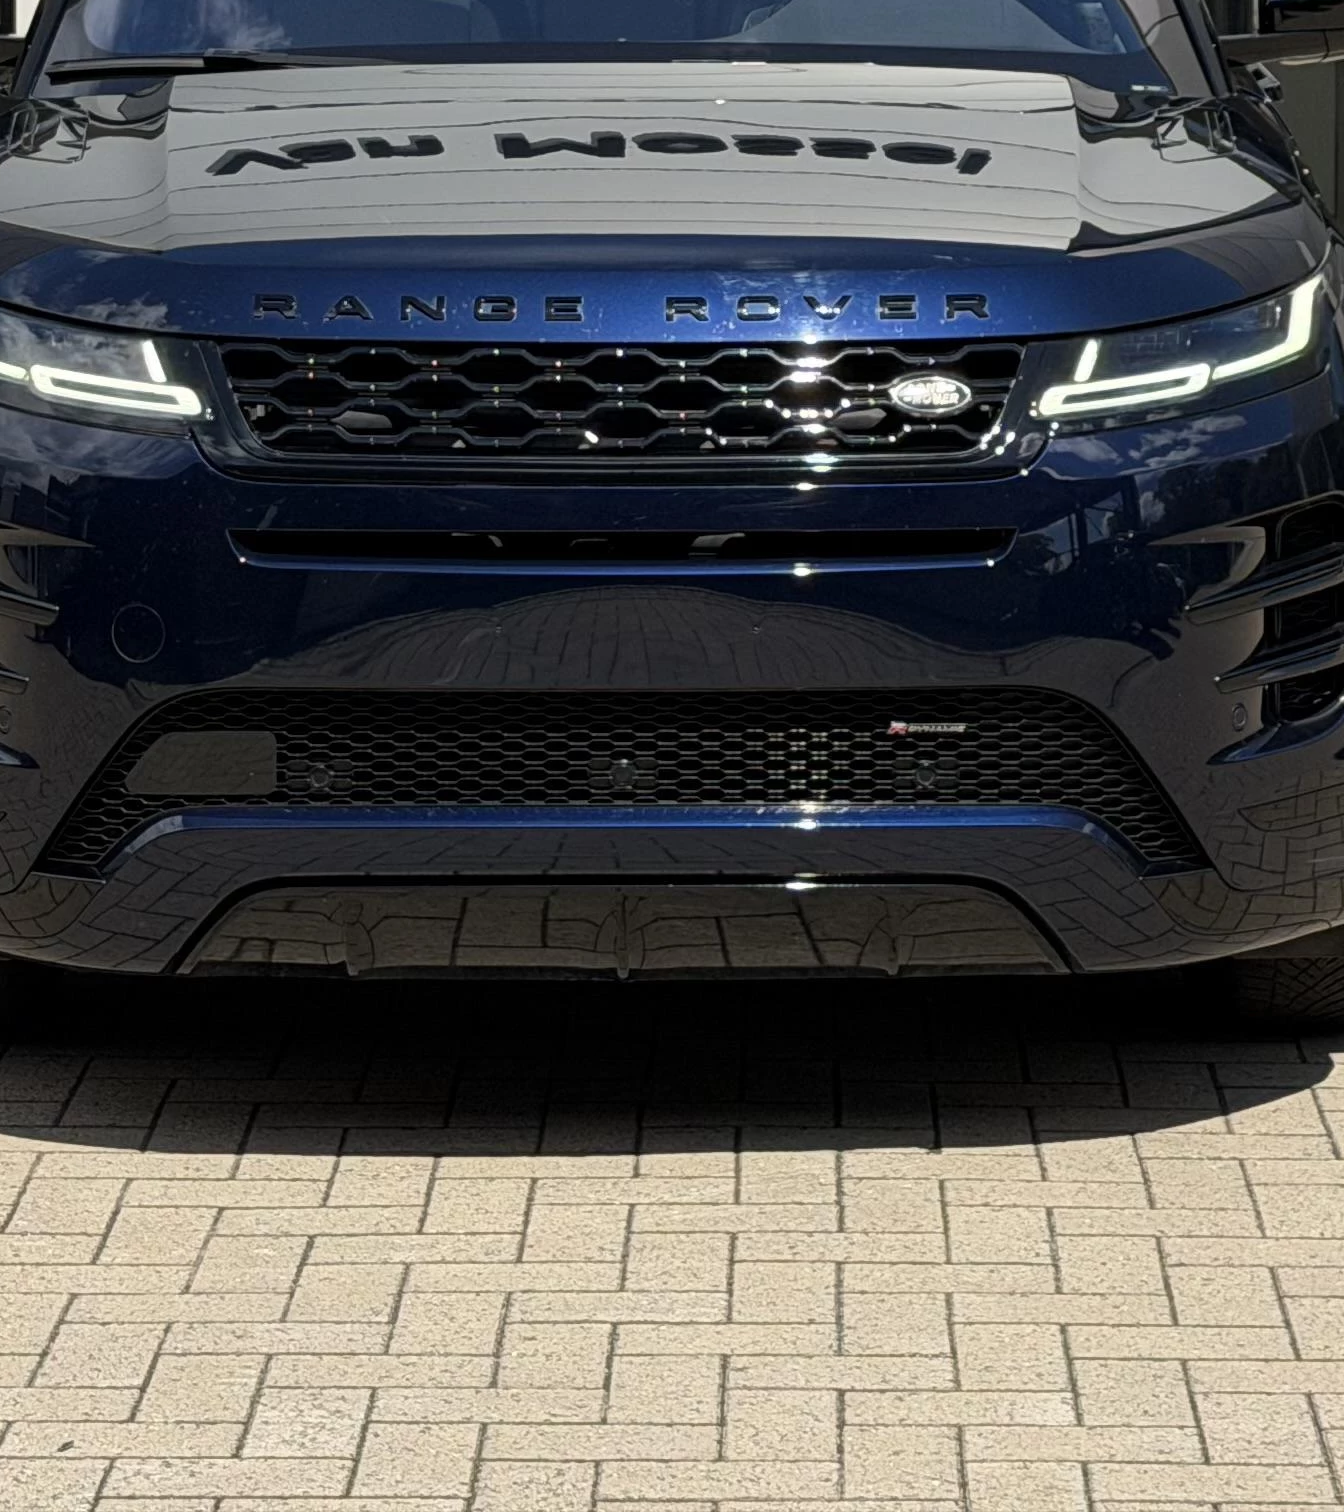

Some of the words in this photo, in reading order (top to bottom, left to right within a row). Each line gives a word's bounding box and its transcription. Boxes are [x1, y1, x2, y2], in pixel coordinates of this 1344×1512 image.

[253, 293, 584, 322] RANGE
[664, 293, 991, 322] ROVER
[911, 392, 960, 406] ROVER
